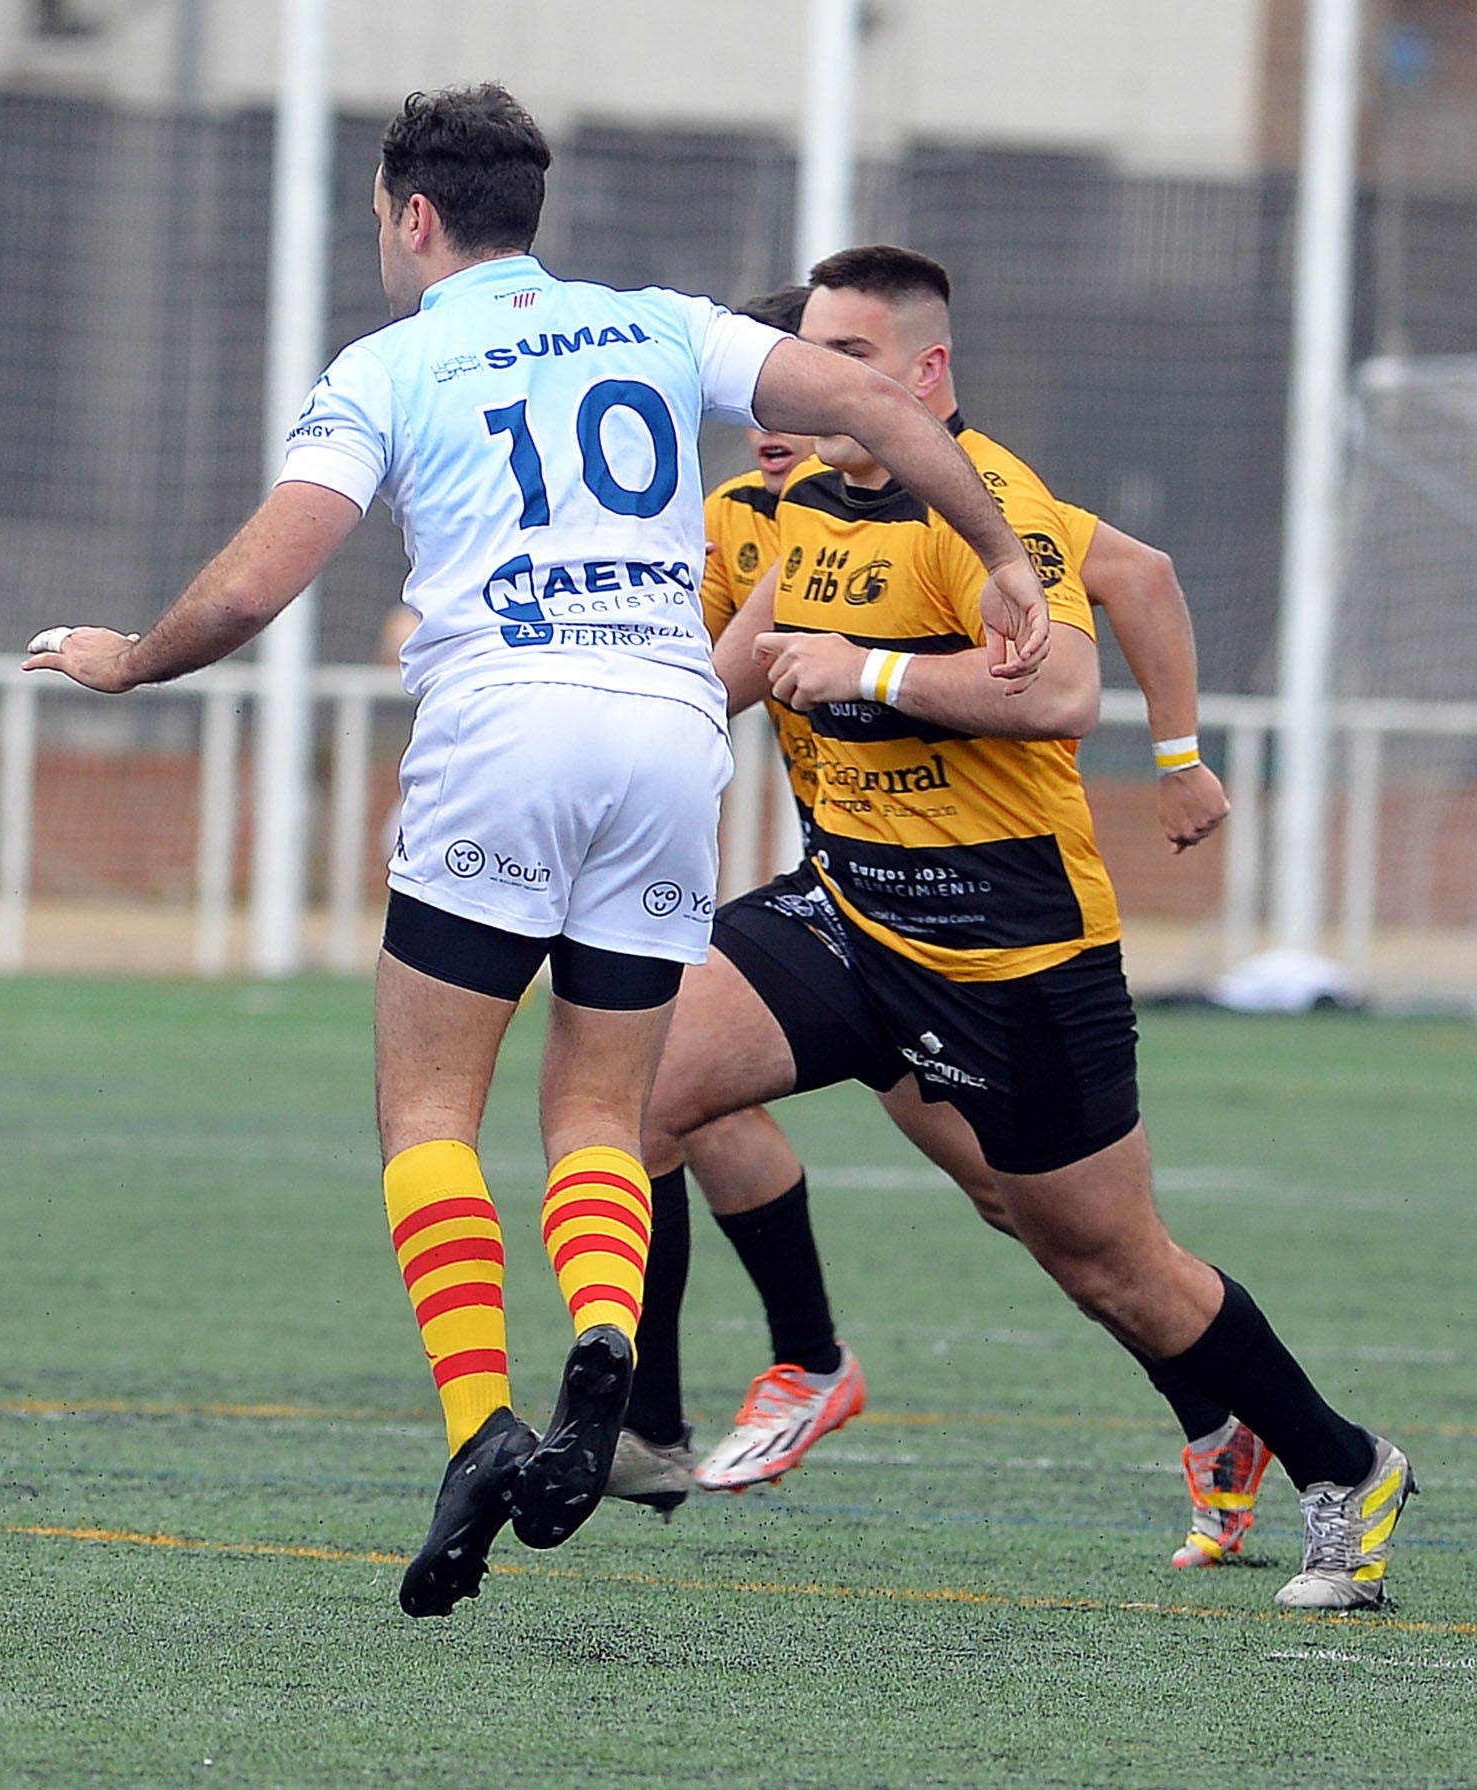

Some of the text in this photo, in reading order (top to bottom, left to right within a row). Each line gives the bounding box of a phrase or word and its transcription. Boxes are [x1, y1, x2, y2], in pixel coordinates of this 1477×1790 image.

[485, 323, 660, 370] SUMAL
[484, 379, 677, 530] 10
[483, 553, 695, 622] NAEKO
